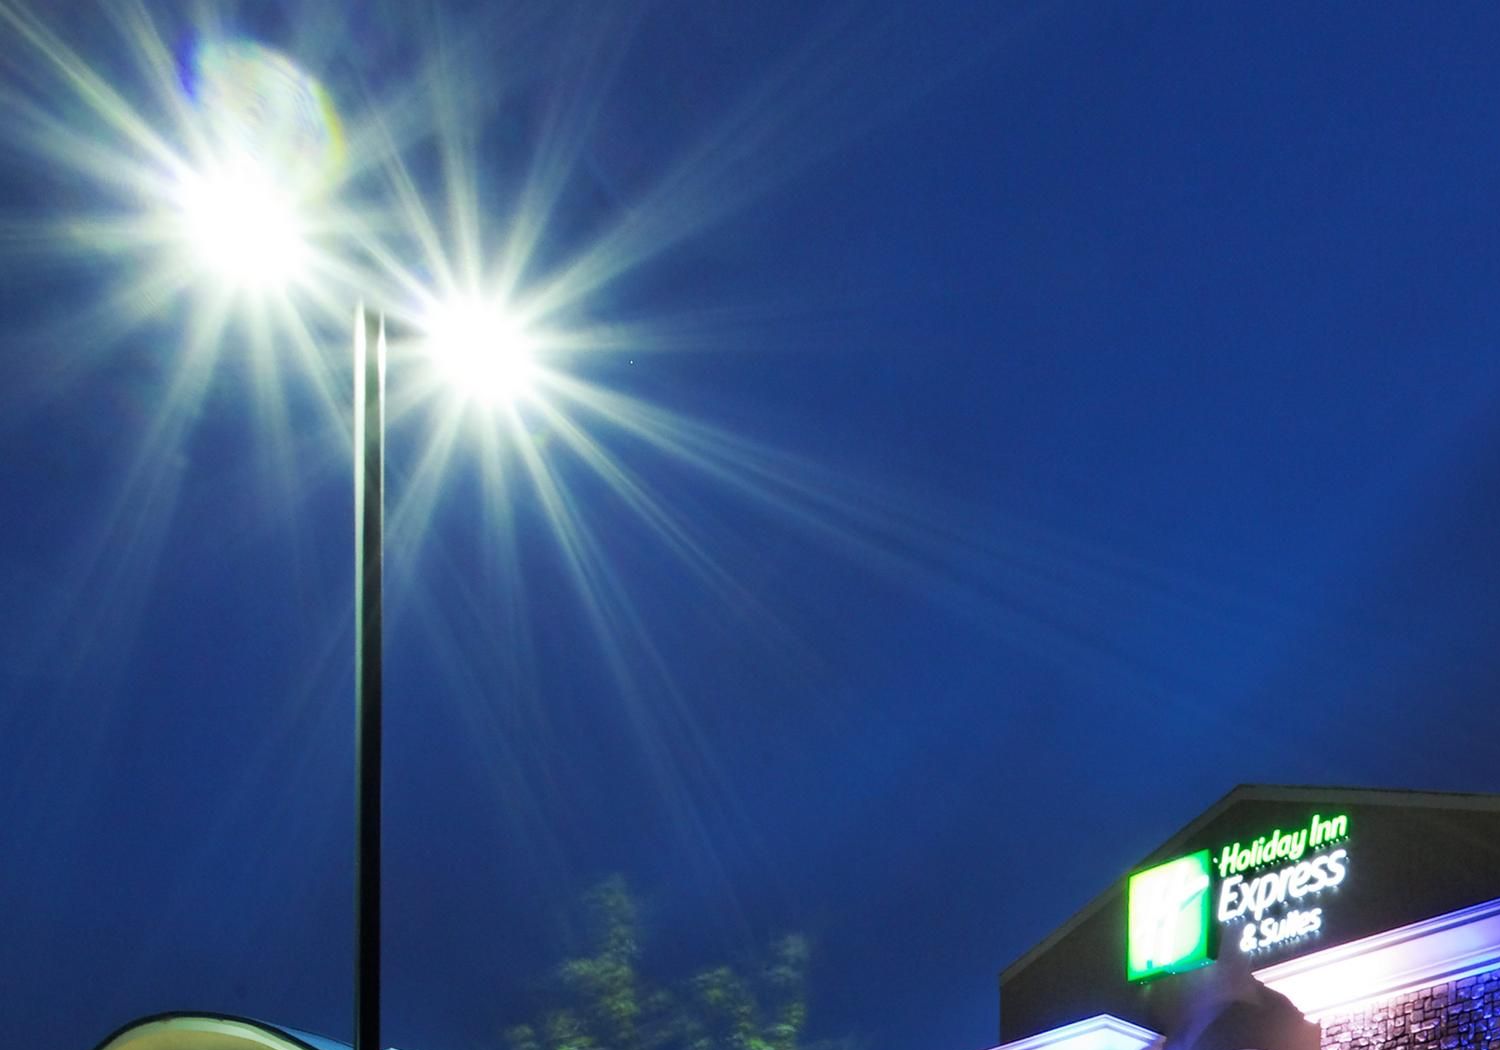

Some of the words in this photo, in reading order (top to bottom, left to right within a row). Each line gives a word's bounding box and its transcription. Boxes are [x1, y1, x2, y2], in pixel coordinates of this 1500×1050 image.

[1219, 829, 1307, 877] Holiday
[1309, 814, 1347, 847] Inn
[1217, 849, 1347, 921] Express
[1239, 923, 1258, 952] &
[1258, 907, 1322, 947] Suites
